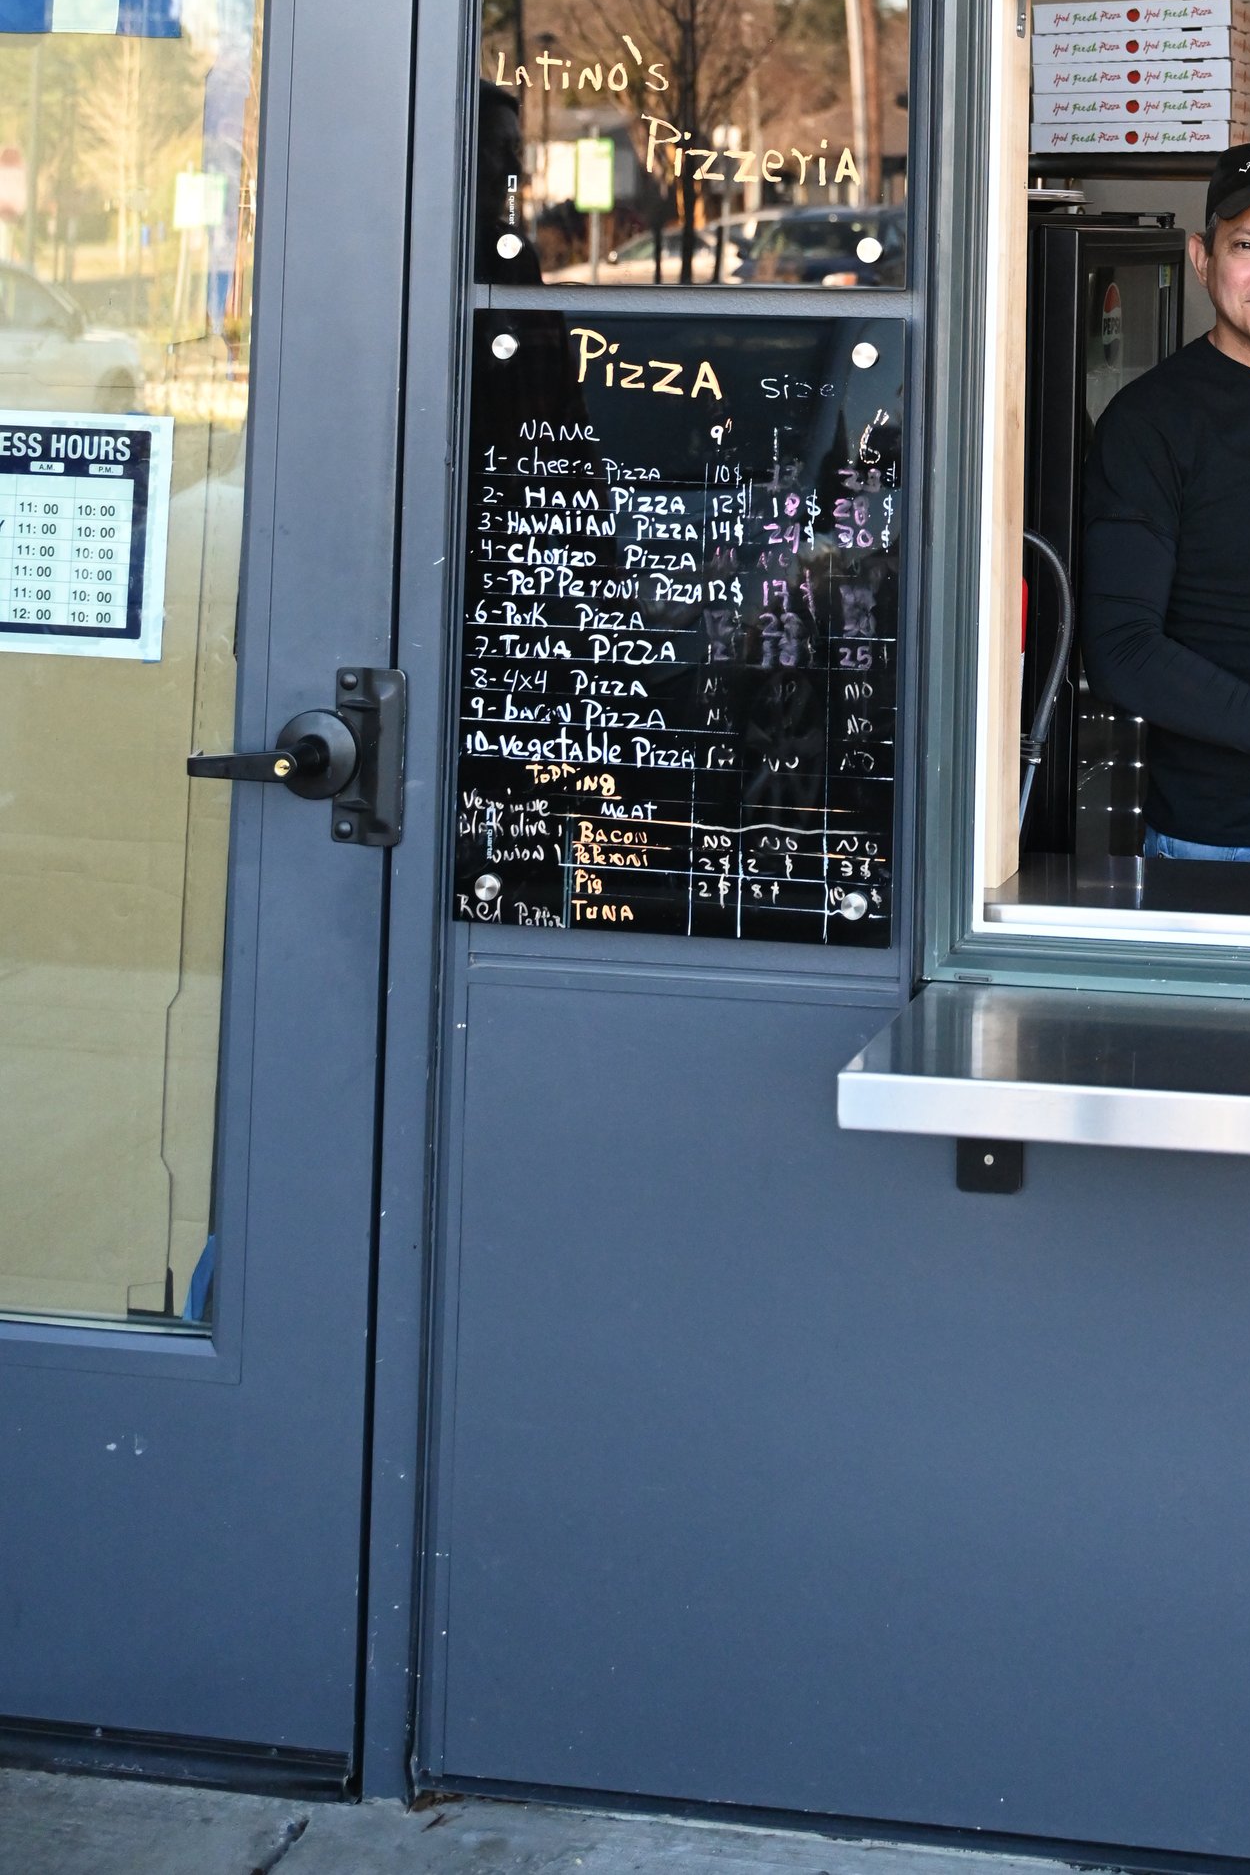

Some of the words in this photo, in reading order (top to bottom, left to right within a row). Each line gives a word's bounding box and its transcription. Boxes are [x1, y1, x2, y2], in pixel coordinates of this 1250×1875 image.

[1100, 11, 1121, 22] Pizza
[1191, 7, 1212, 18] Pizza
[1100, 72, 1121, 83] Pizza
[50, 433, 131, 462] HOURS
[98, 466, 114, 474] P.M.
[525, 486, 599, 509] HAM
[578, 821, 648, 843] BACON
